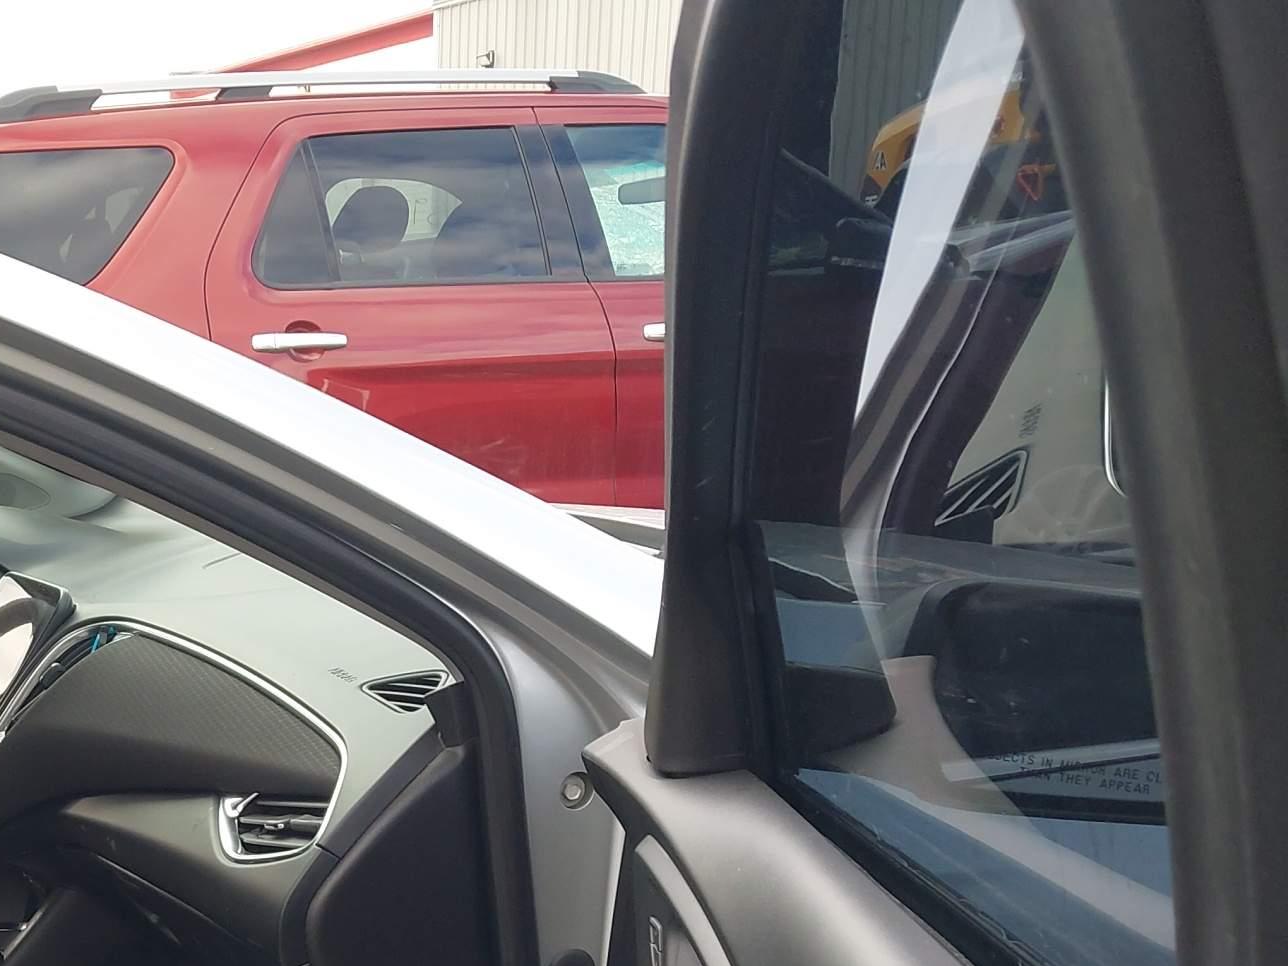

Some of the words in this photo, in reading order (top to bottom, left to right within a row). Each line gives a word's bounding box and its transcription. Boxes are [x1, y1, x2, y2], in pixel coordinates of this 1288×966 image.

[1041, 757, 1053, 768] IN
[1113, 767, 1140, 780] ARE
[1098, 779, 1151, 796] APPEAR
